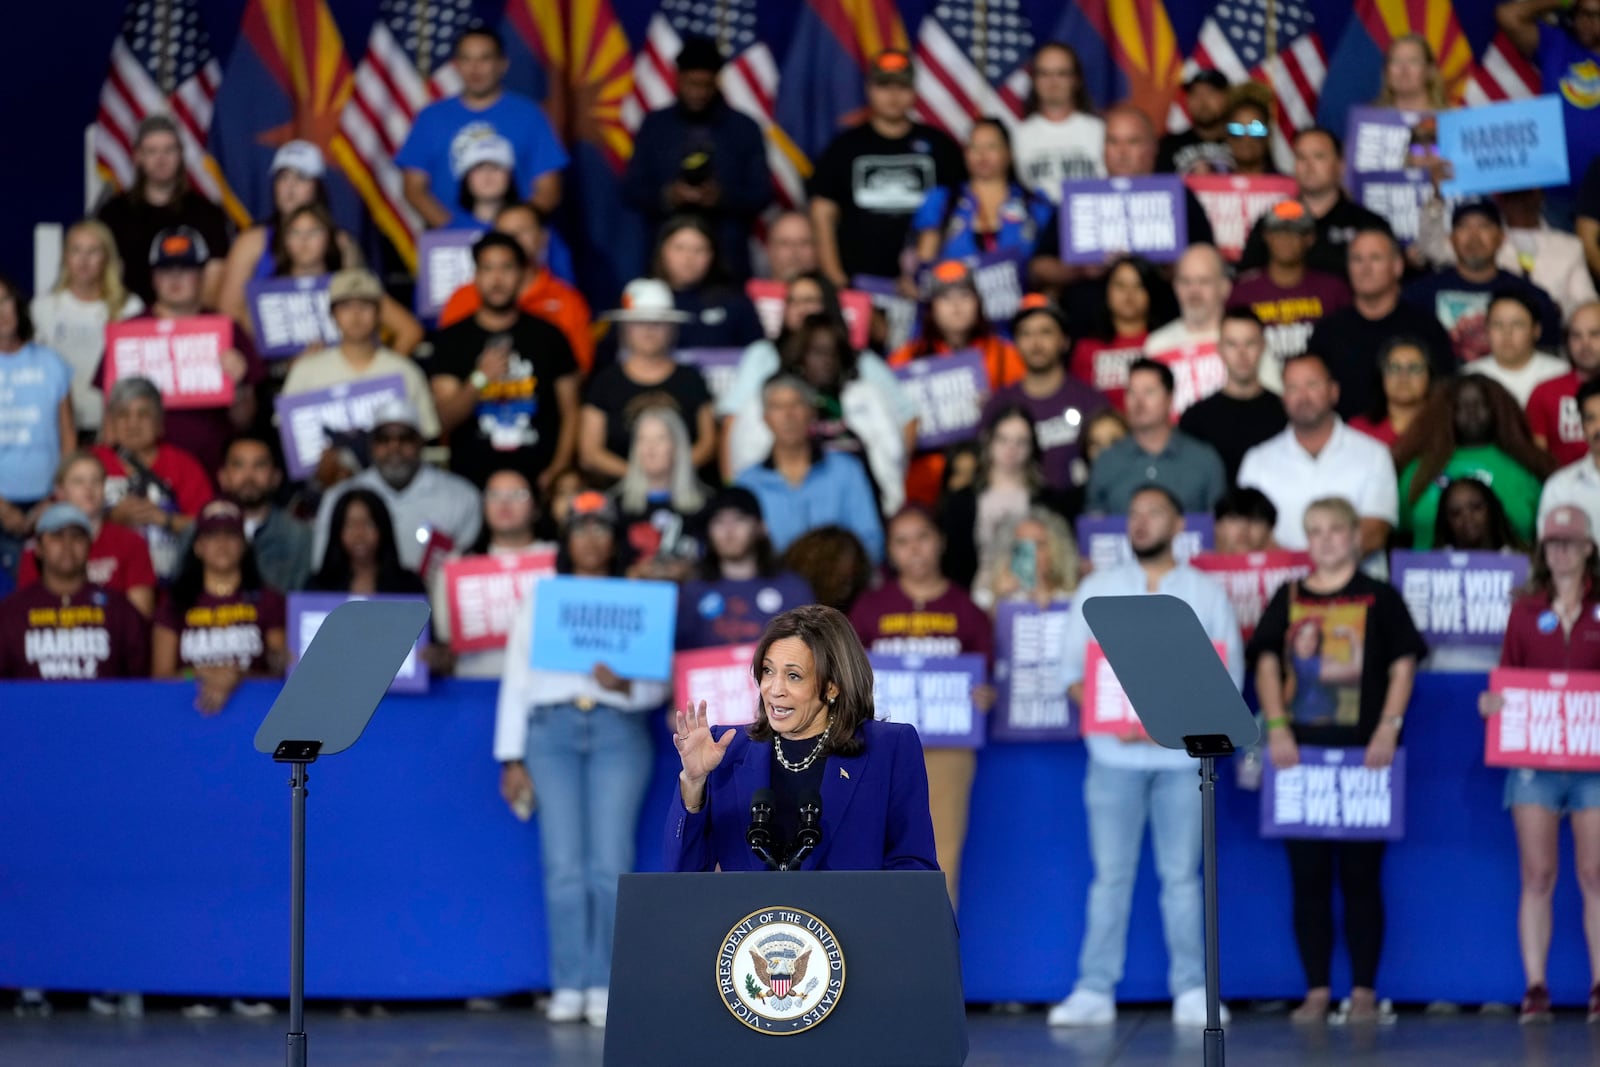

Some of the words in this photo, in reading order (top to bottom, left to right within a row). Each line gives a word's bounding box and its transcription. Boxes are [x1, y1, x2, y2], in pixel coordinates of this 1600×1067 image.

[1461, 118, 1539, 155] HARRIS
[1432, 569, 1461, 600] WE
[1464, 569, 1514, 602] VOTE
[24, 627, 110, 663] HARRIS
[180, 624, 263, 662] HARRIS
[1529, 689, 1561, 721] WE
[1564, 690, 1600, 722] VOT
[1529, 720, 1564, 754] WE
[1566, 720, 1600, 756] WI
[759, 913, 774, 924] OF
[779, 911, 801, 924] THE
[720, 918, 753, 995] PRESIDENT
[806, 918, 841, 971] UNITED
[730, 998, 760, 1027] VICE
[802, 979, 840, 1026] STATES
